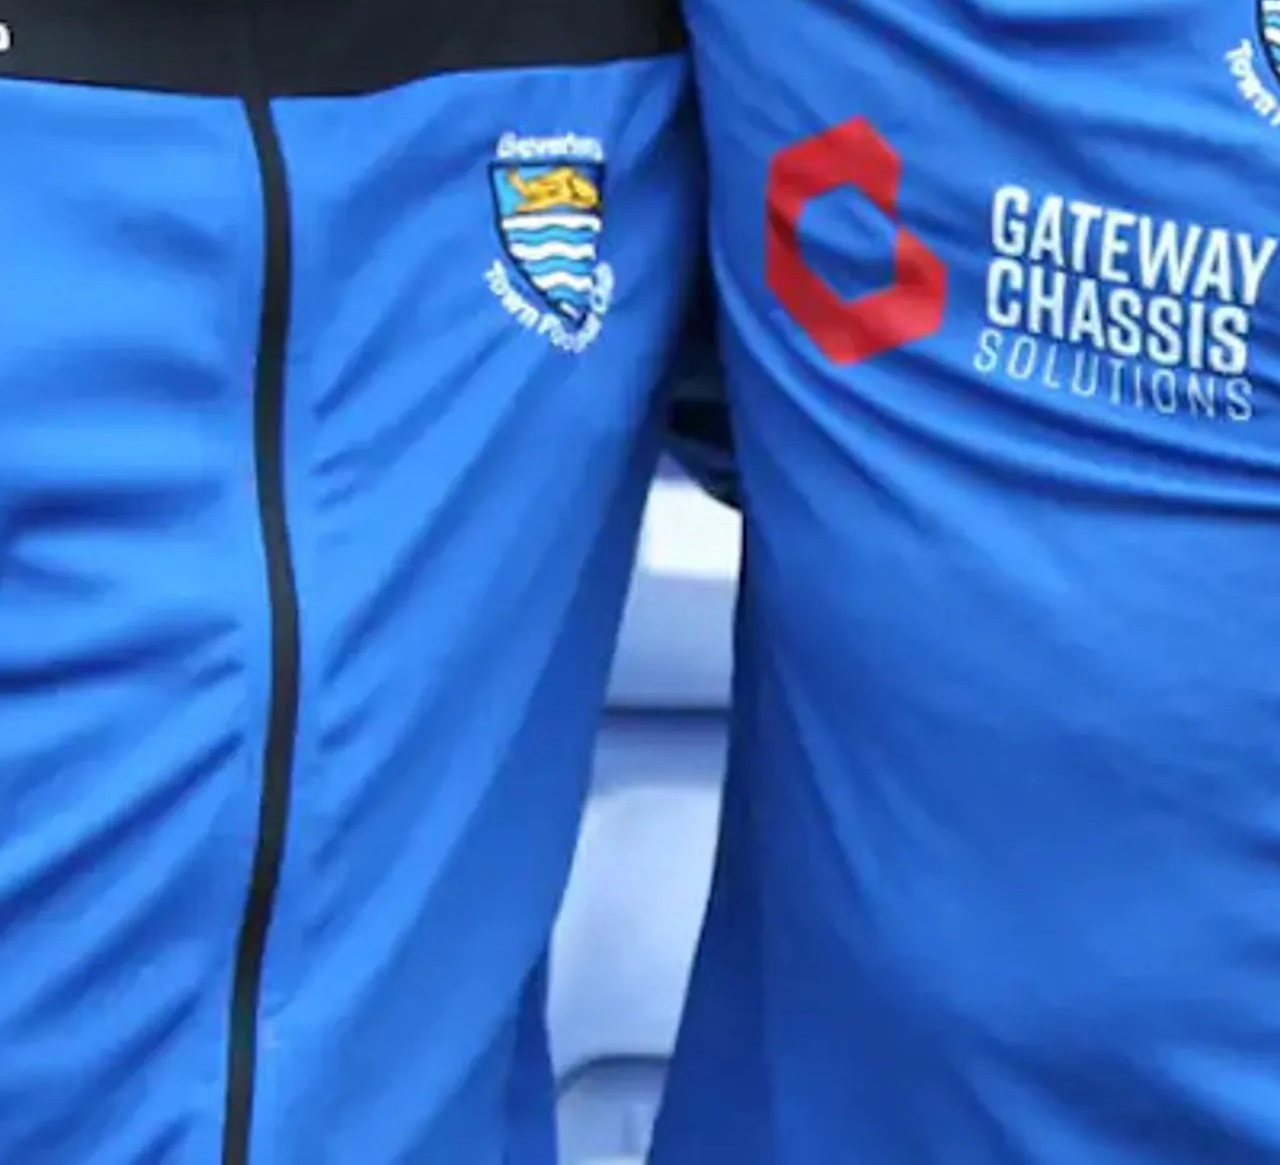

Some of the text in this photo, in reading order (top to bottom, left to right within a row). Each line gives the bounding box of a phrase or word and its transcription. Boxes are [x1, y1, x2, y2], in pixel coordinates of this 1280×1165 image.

[1225, 38, 1277, 115] Town
[992, 184, 1278, 306] GATEWAY
[986, 257, 1249, 375] CHASSIS
[973, 329, 1254, 422] SOLUTIONS
